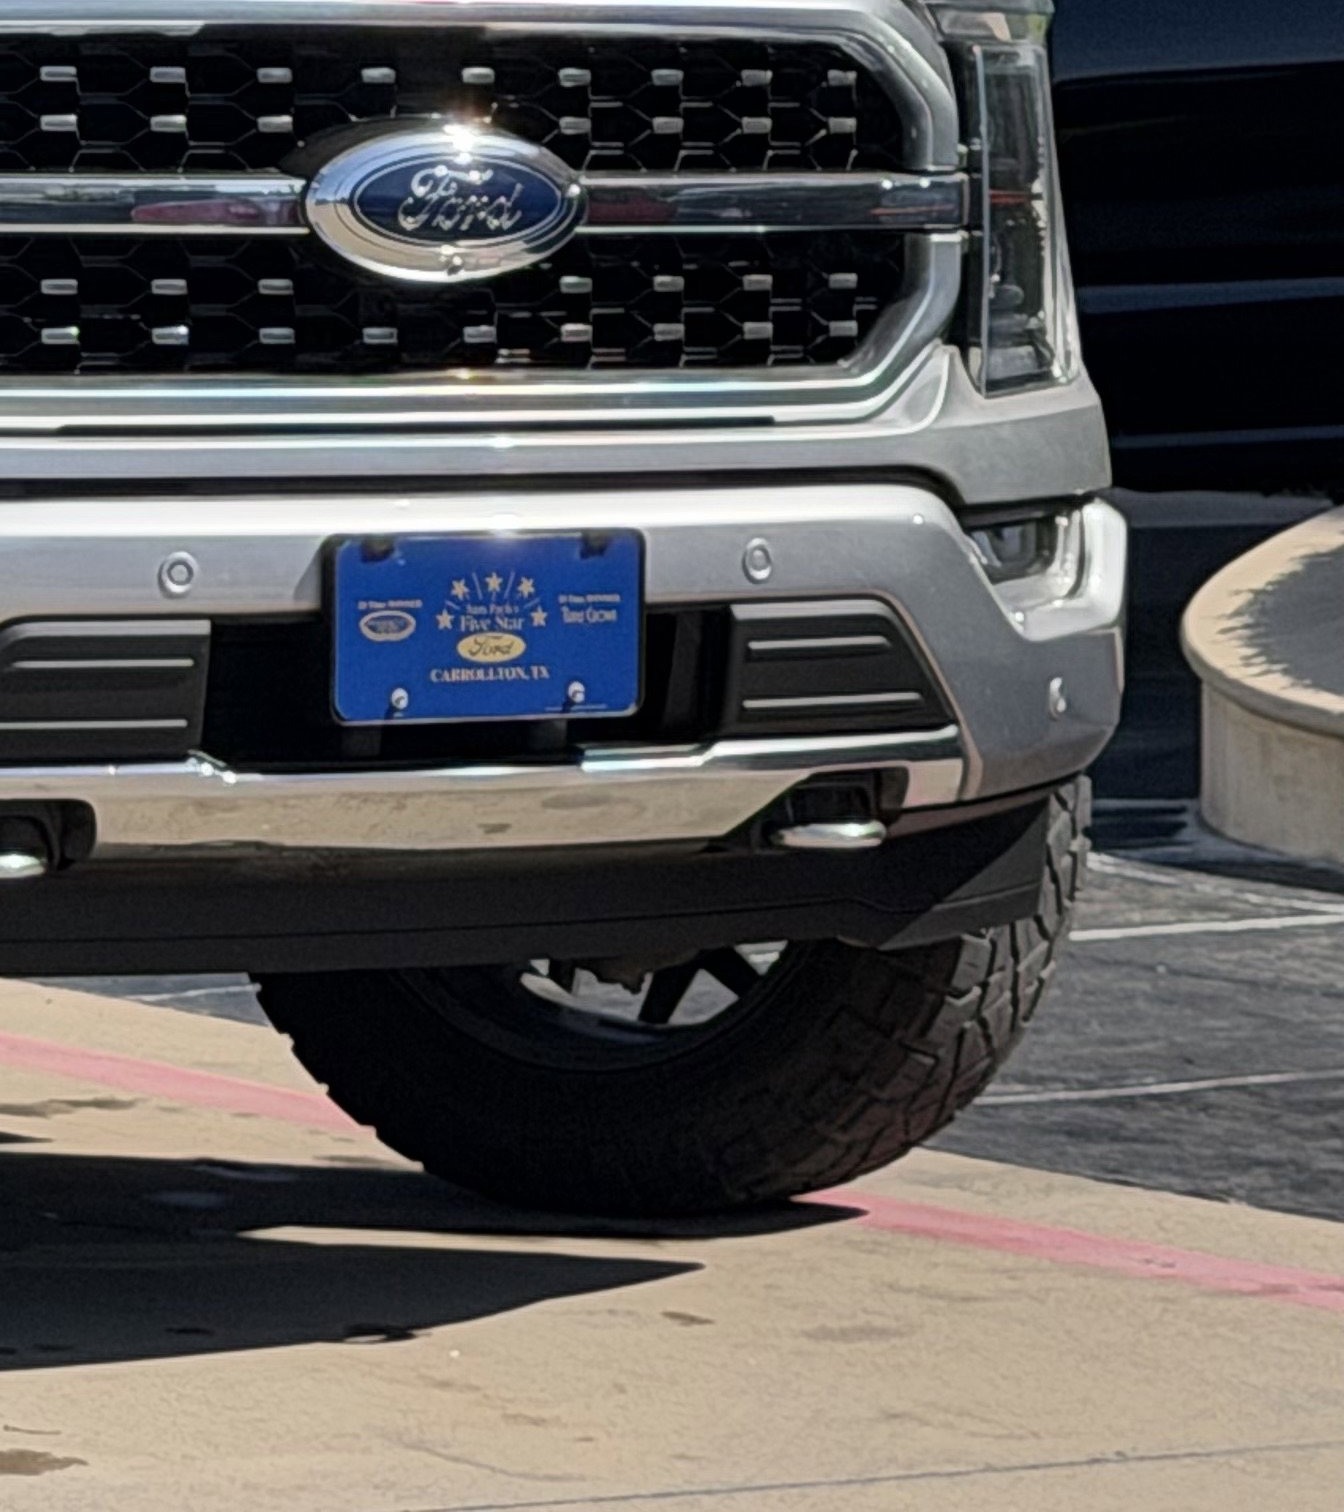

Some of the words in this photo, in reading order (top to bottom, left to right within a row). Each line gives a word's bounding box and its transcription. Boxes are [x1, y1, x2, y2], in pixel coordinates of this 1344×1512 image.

[397, 164, 524, 232] Ford
[460, 615, 492, 632] Five
[495, 615, 525, 631] Star
[468, 635, 514, 656] Ford
[530, 665, 551, 680] TX
